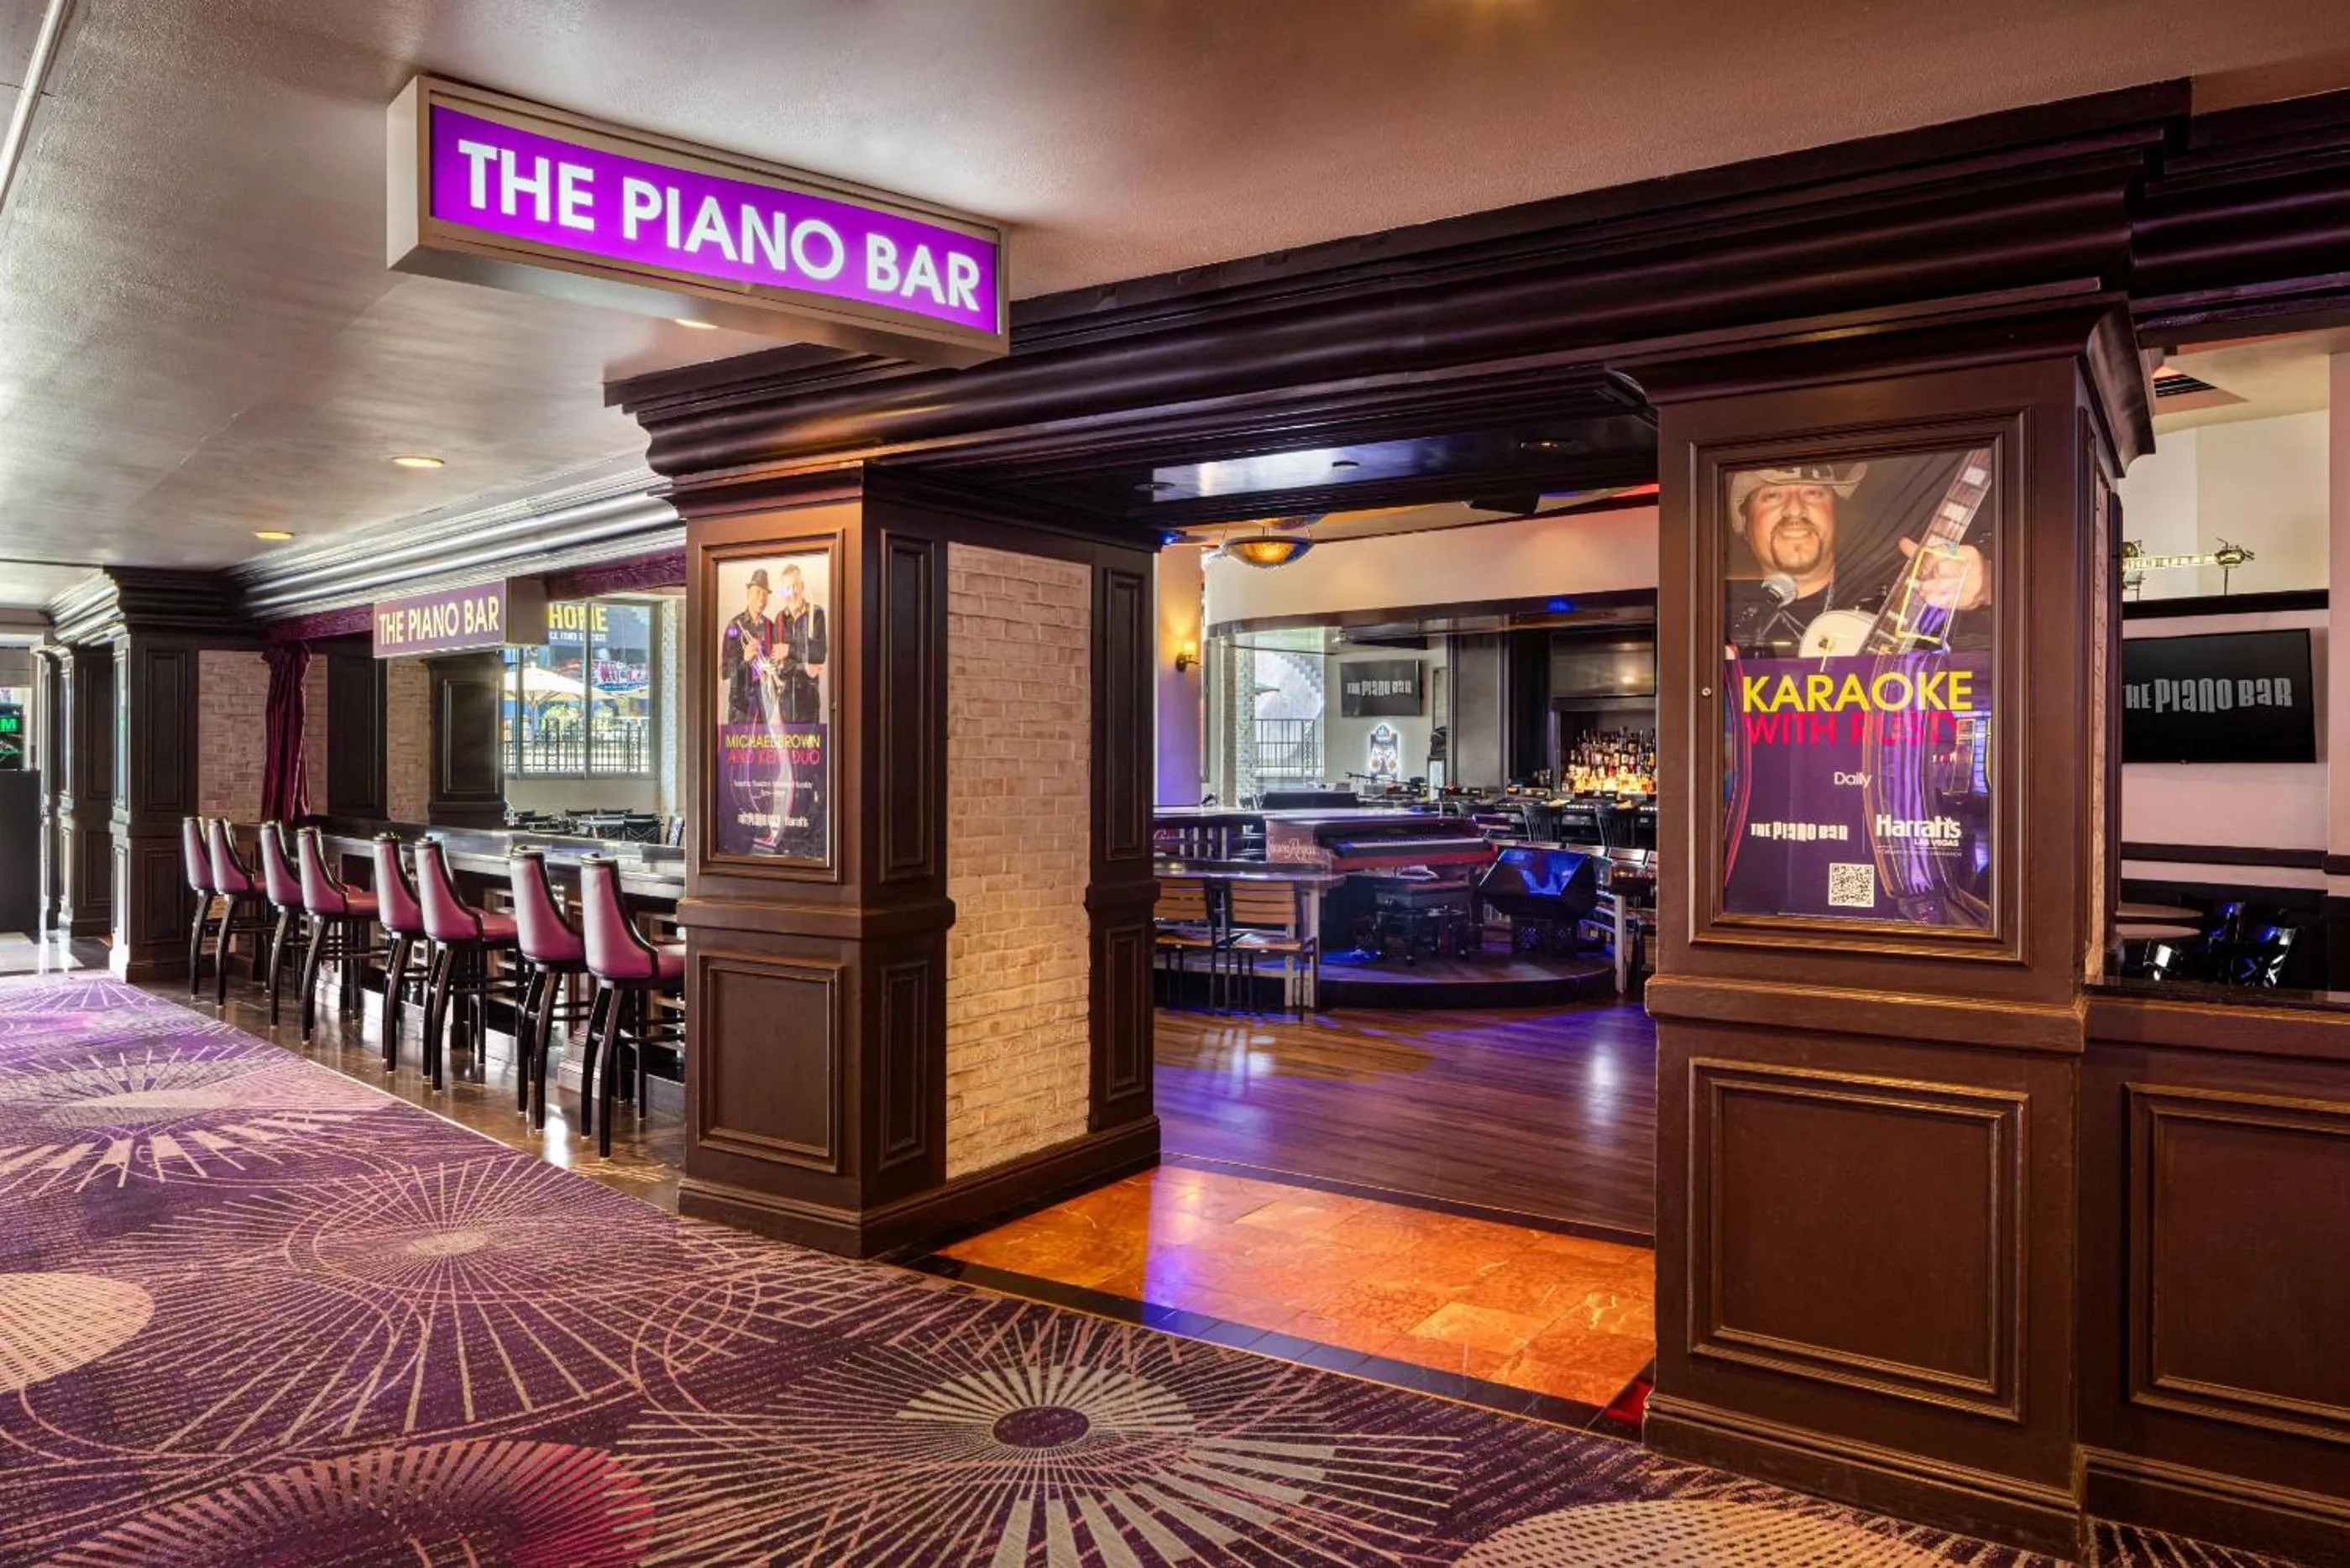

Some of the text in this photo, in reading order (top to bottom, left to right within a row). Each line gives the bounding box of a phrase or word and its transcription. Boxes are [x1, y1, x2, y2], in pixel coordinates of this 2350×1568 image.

[458, 139, 981, 311] THE PIANO BAR
[379, 596, 499, 645] THE PIANO BAR
[1742, 671, 1973, 713] KARAOKE
[1743, 713, 1836, 745] WITH
[1834, 771, 1872, 788] Daily
